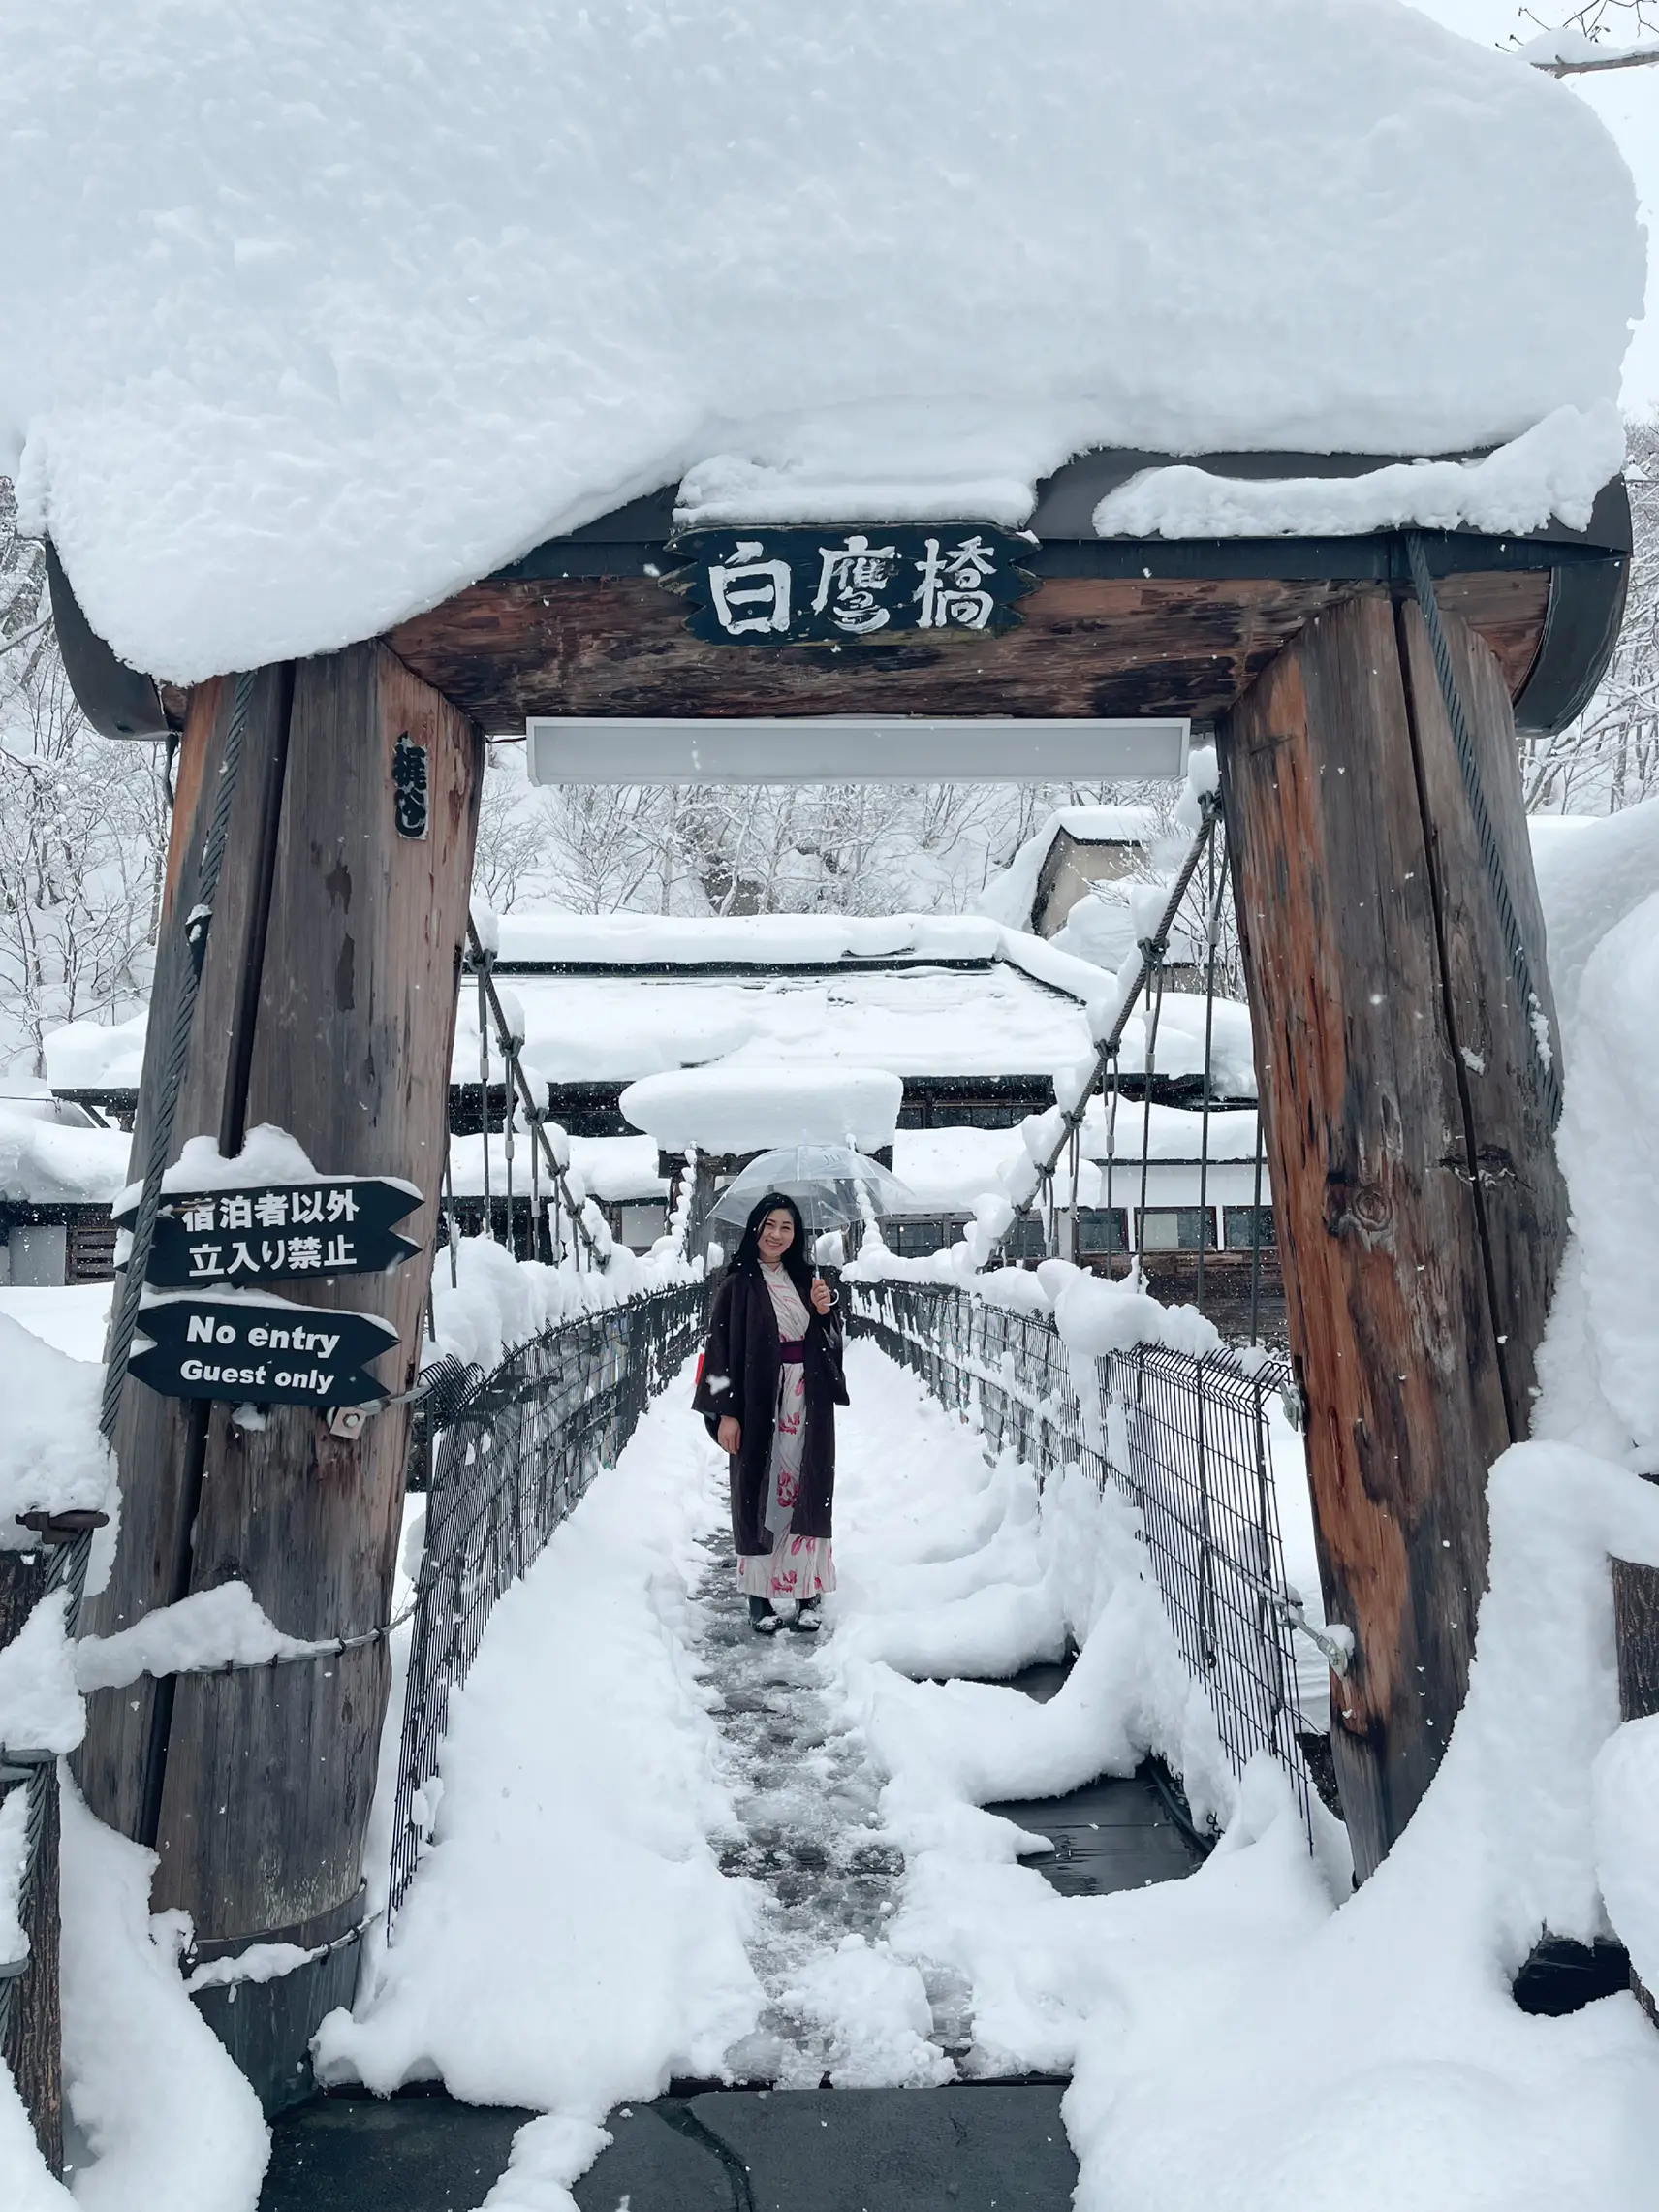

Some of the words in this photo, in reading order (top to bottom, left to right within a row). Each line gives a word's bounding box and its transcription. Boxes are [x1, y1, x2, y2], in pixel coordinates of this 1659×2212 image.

[708, 535, 998, 634] 白鷹橋
[181, 1189, 360, 1232] 宿泊者以外
[189, 1234, 358, 1277] 立入り禁止
[186, 1315, 236, 1344] No
[247, 1325, 340, 1359] entry
[180, 1359, 266, 1385] Guest
[274, 1369, 335, 1394] only
